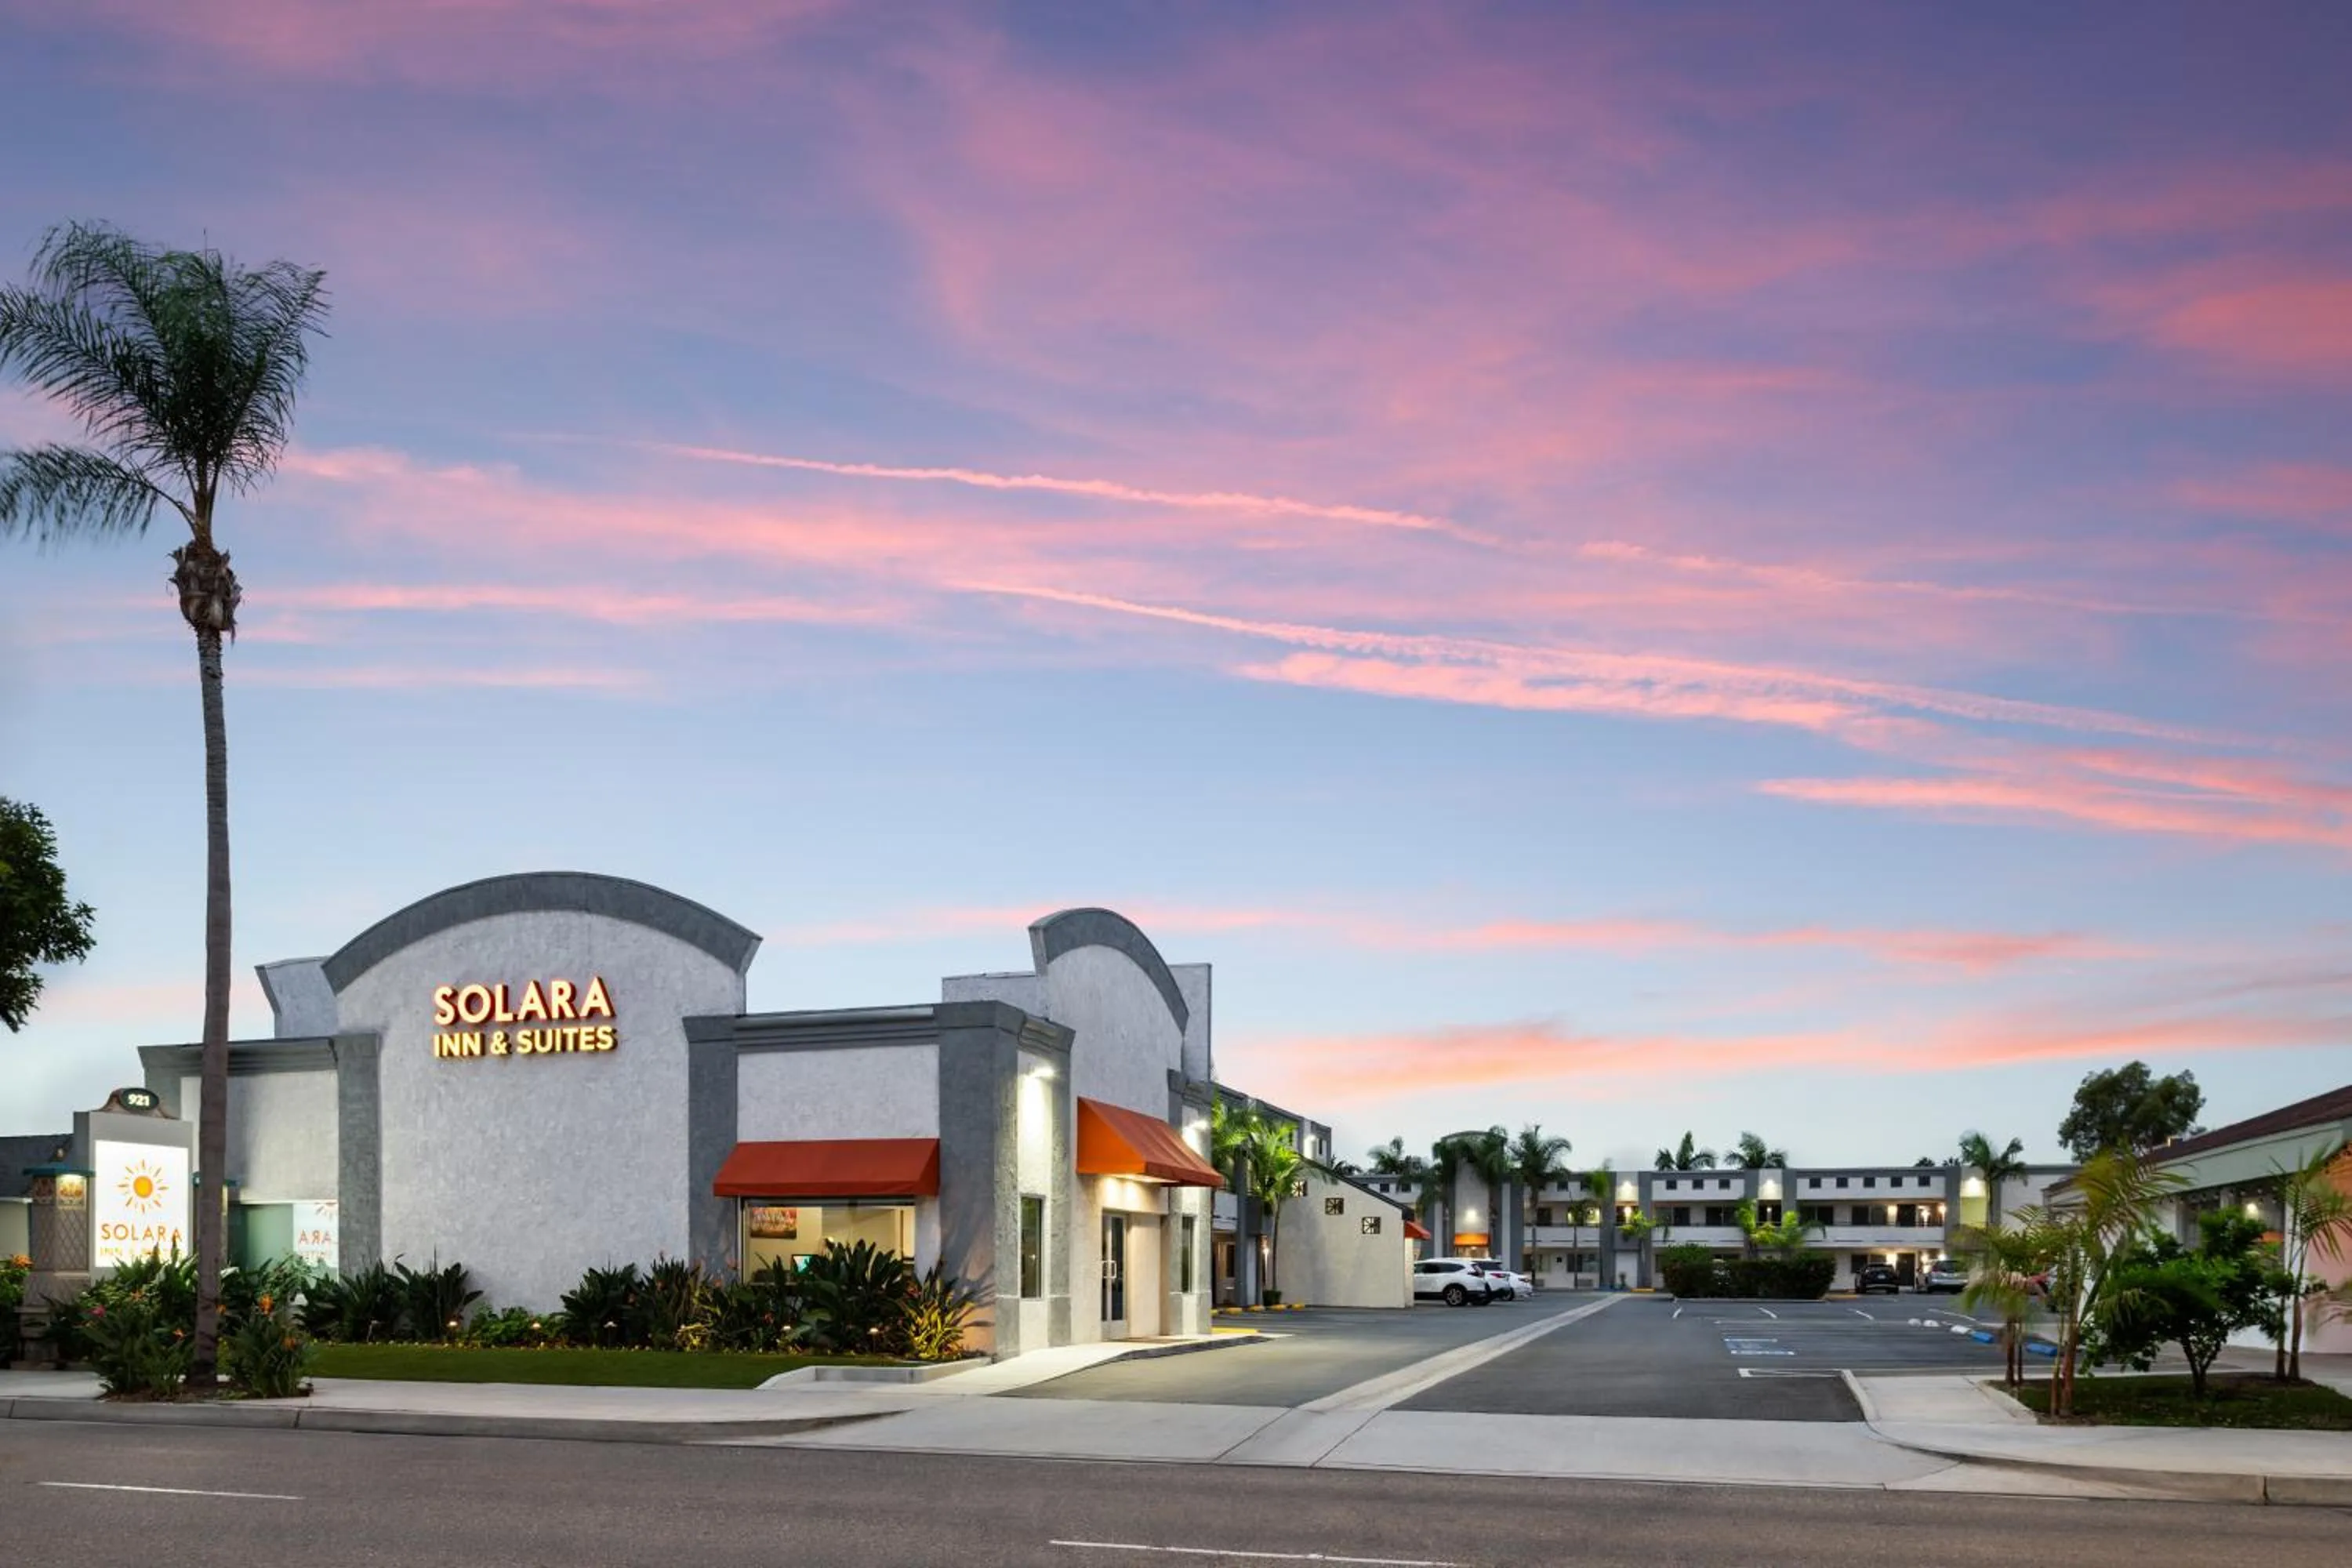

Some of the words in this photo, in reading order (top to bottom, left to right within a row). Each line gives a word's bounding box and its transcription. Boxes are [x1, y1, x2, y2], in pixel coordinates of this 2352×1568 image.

[434, 976, 616, 1025] SOLARA
[433, 1030, 485, 1057] INN
[490, 1030, 511, 1054] &
[516, 1025, 618, 1054] SUITES
[128, 1094, 150, 1106] 921
[101, 1223, 183, 1242] SOLARA
